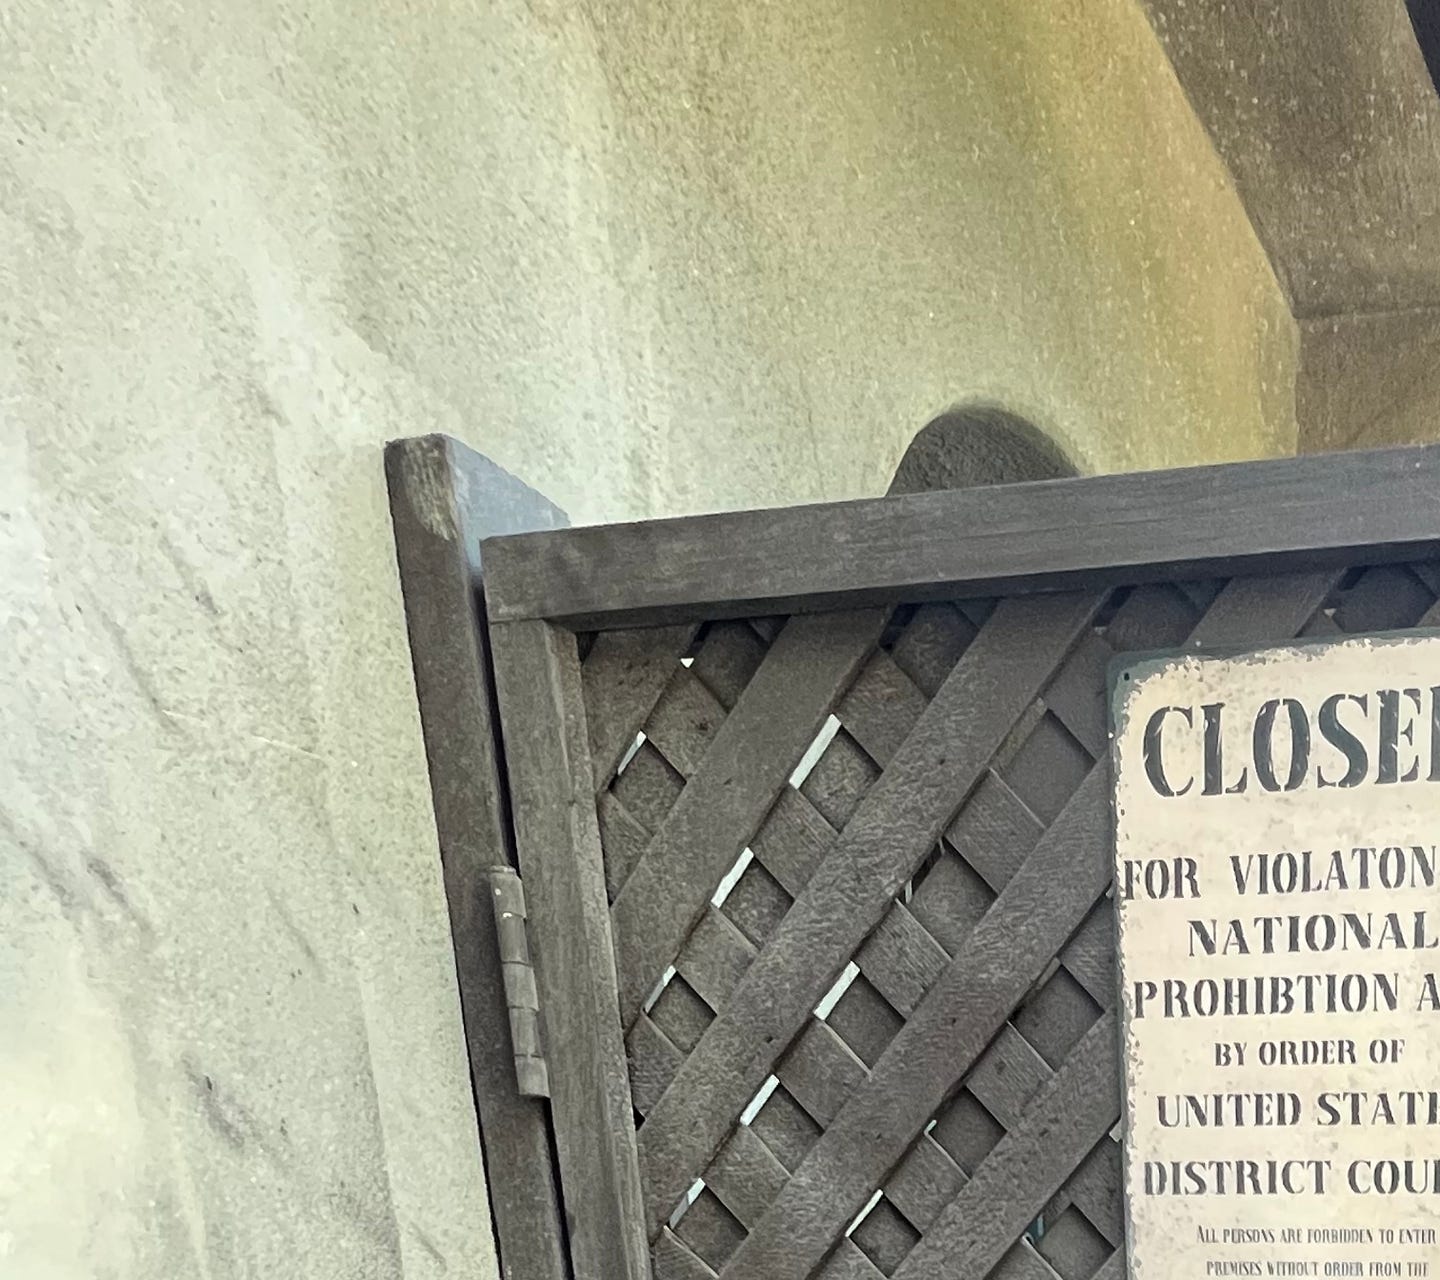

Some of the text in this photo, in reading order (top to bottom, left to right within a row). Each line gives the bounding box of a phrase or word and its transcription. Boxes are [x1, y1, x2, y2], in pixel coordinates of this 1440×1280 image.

[1123, 856, 1200, 900] FOR
[1229, 845, 1436, 895] VIOLATON
[1188, 911, 1440, 957] NATIONAL
[1133, 973, 1399, 1018] PROHIBTION
[1214, 1039, 1406, 1066] BY ORDER OF
[1157, 1093, 1301, 1128] UNITED
[1144, 1159, 1331, 1196] DISTRICT
[1223, 1227, 1275, 1244] PERSONS
[1280, 1227, 1303, 1244] ARE
[1307, 1227, 1374, 1244] FORBIDDEN
[1379, 1227, 1395, 1244] TO
[1399, 1227, 1436, 1244] ENTER
[1206, 1260, 1429, 1277] PREMISES WITHOUT ORDER FROM THE
